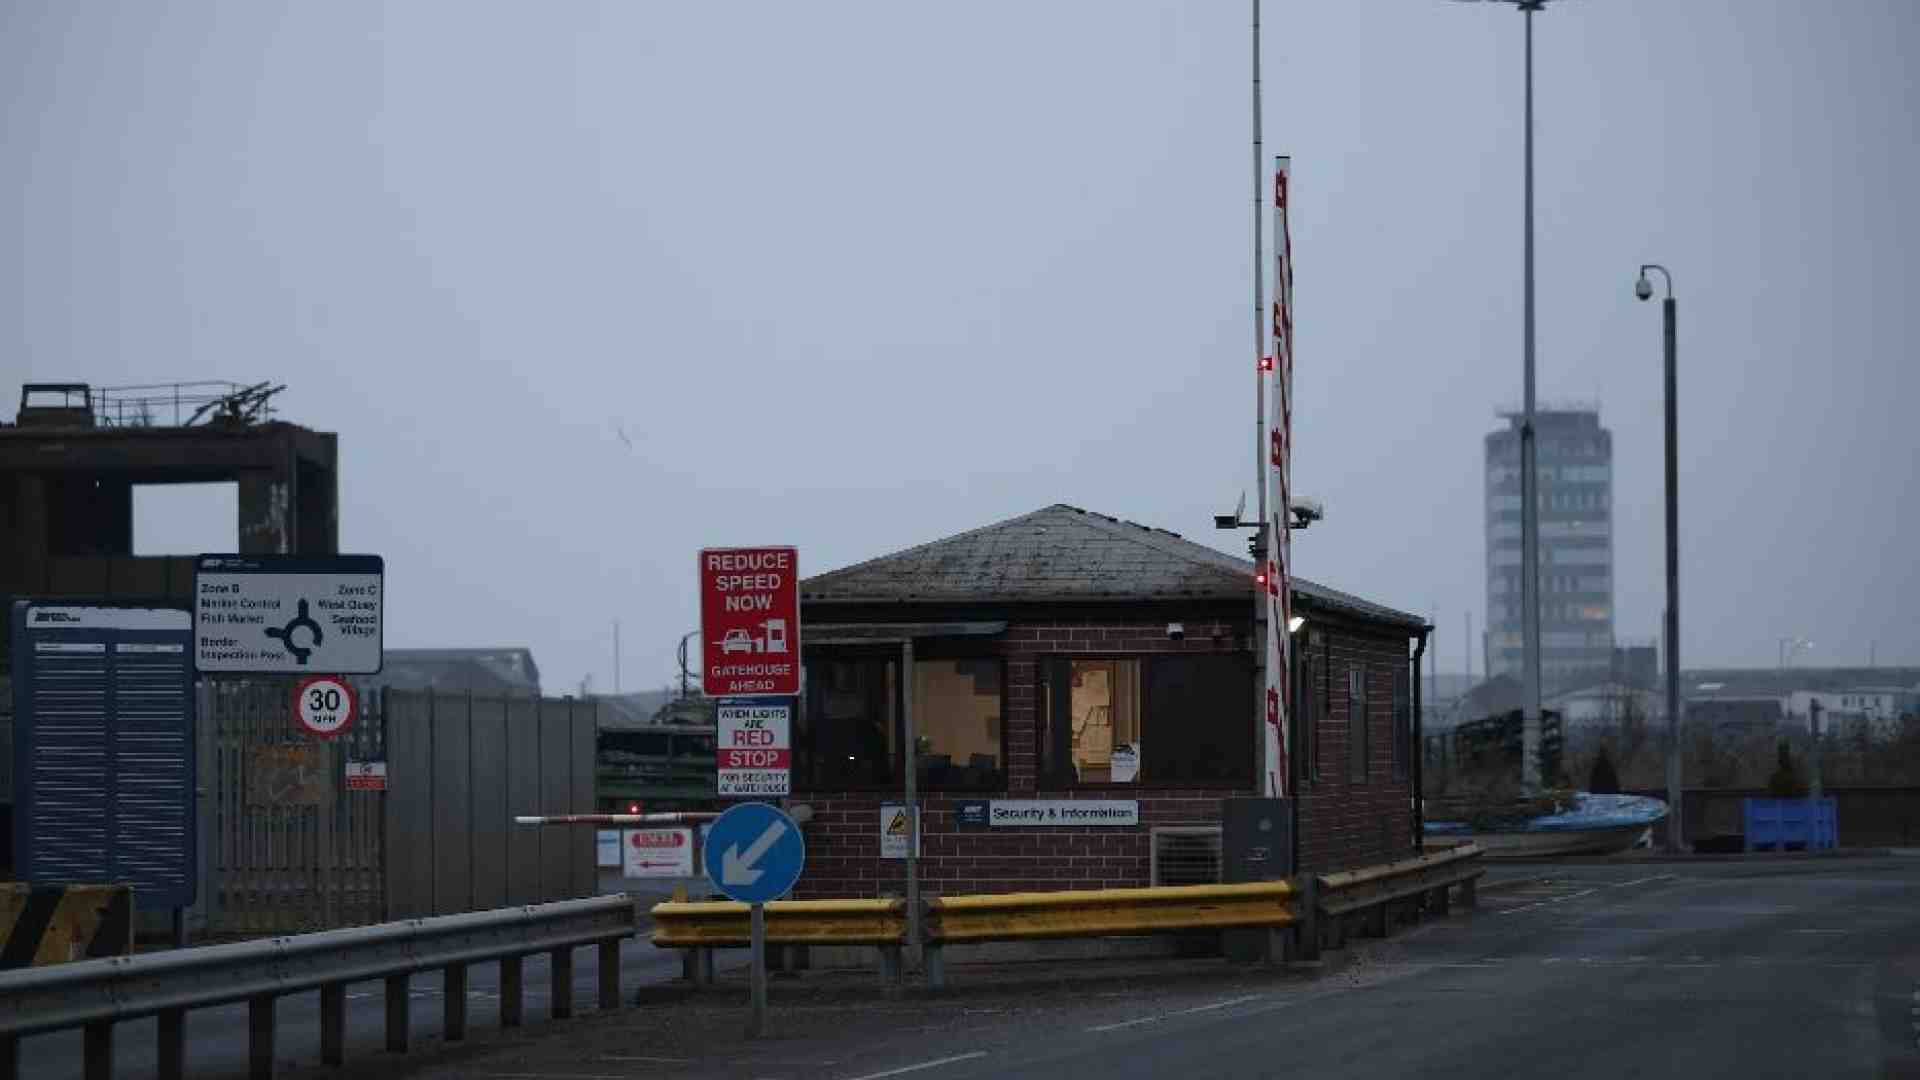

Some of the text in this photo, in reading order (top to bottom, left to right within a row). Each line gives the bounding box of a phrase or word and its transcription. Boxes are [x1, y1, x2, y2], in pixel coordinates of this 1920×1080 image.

[708, 553, 788, 571] REDUCE
[201, 583, 229, 593] Zone
[715, 574, 781, 592] SPEED
[338, 584, 377, 595] Zone C
[240, 599, 281, 610] Control
[317, 600, 377, 611] West Quay
[725, 594, 773, 612] NOW
[201, 613, 225, 624] Fish
[331, 614, 377, 624] Seafood
[201, 636, 238, 646] Border
[201, 651, 258, 662] Inspection
[712, 664, 791, 678] GATEHOUSE
[729, 680, 775, 691] AHEAD
[310, 688, 340, 711] 30
[313, 715, 336, 723] MPH
[720, 709, 787, 719] WHEN LIGHTS
[744, 720, 763, 728] ARE
[733, 730, 775, 745] RED
[730, 750, 779, 766] STOP
[743, 773, 786, 783] SECURITY
[993, 807, 1043, 821] Security
[1048, 807, 1058, 818] &
[1061, 807, 1133, 818] Information
